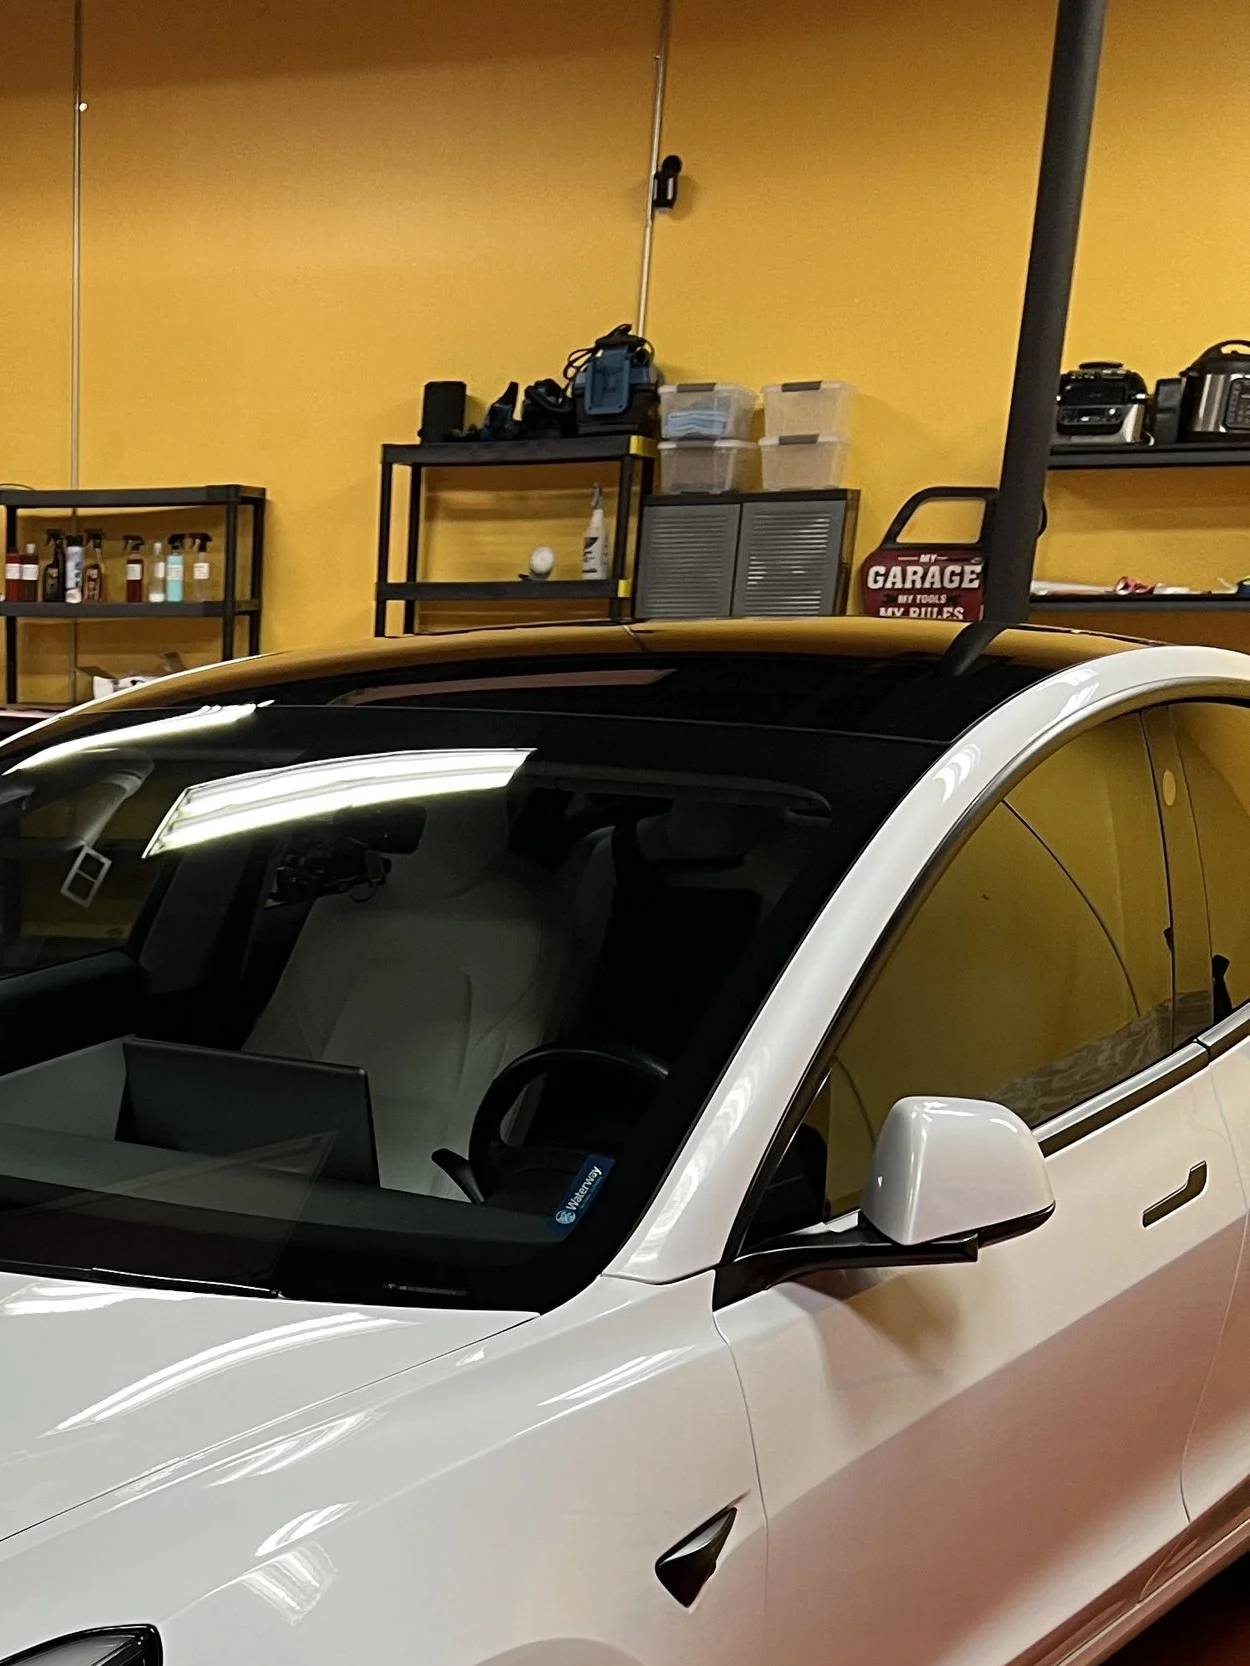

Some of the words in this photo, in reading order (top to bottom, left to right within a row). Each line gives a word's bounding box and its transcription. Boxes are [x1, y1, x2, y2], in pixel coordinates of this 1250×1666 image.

[918, 554, 938, 563] MY
[867, 565, 984, 589] GARAGE
[897, 594, 913, 604] MY
[916, 594, 947, 604] TOOLS
[565, 1165, 603, 1211] Waterway
